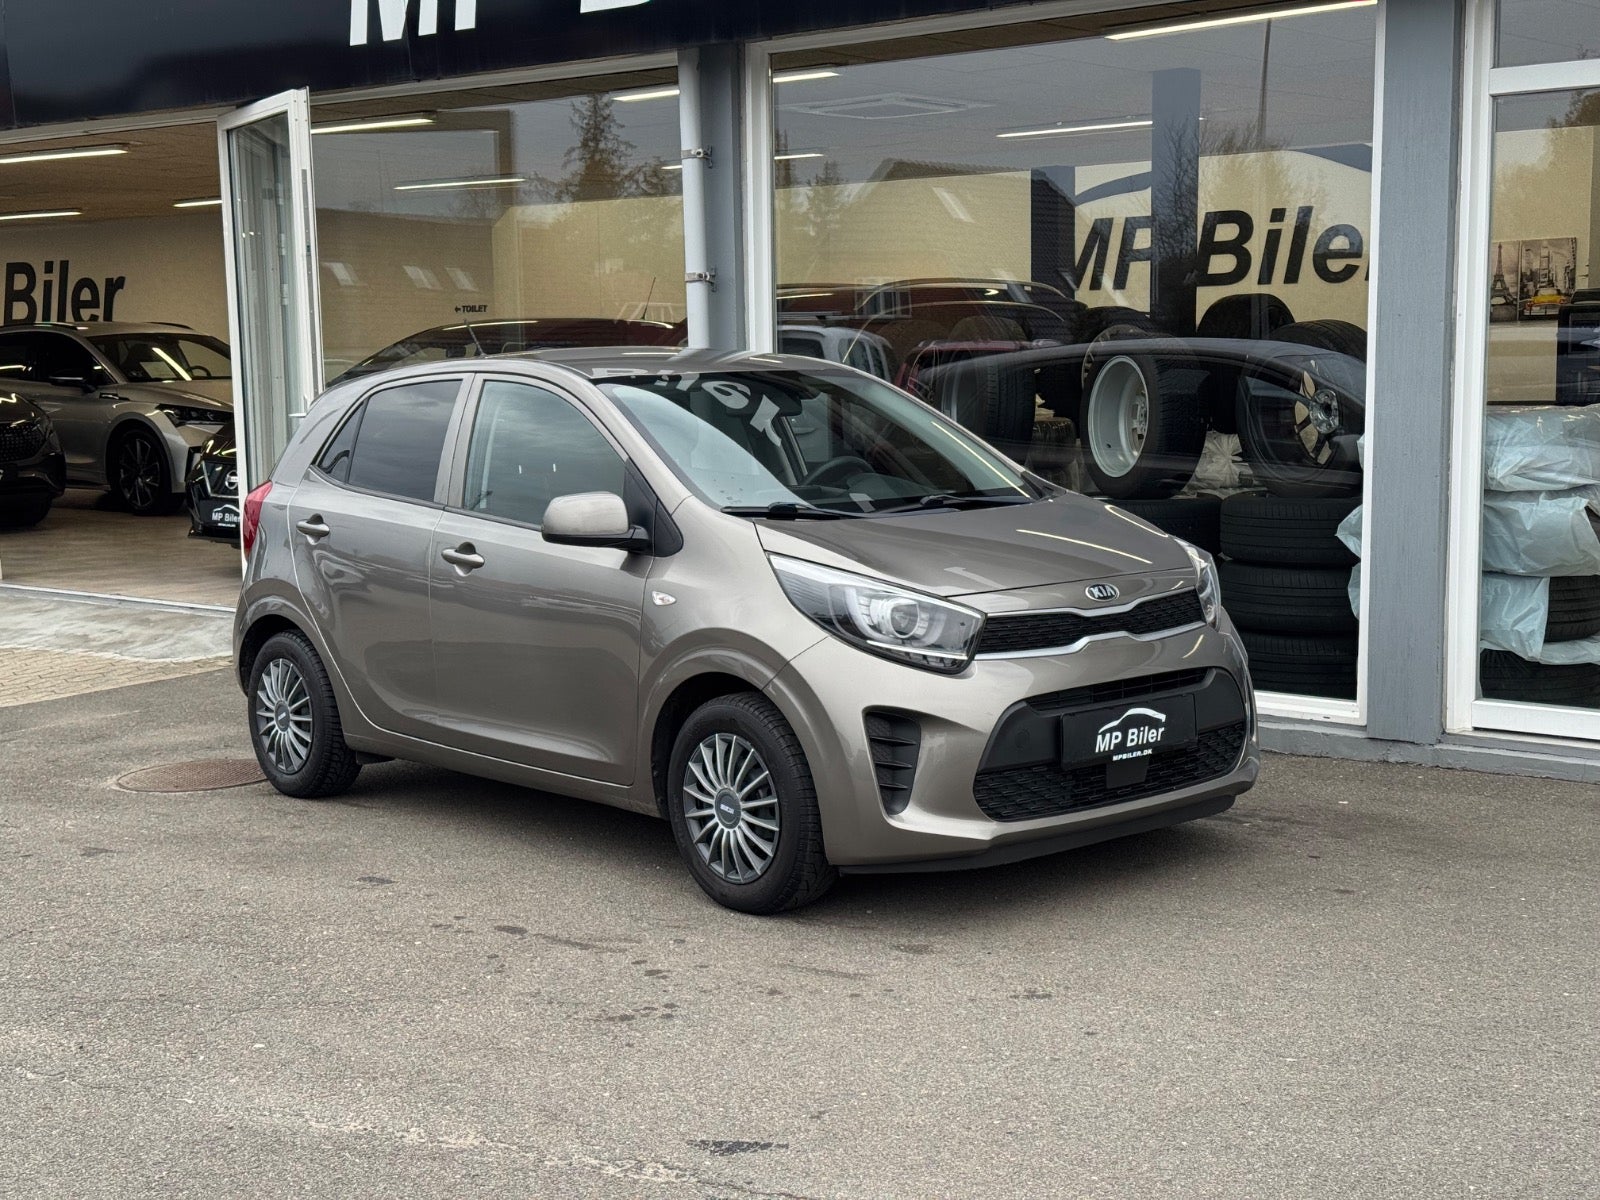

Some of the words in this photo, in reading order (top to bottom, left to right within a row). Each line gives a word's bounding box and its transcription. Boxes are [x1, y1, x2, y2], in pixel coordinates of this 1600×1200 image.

[1197, 206, 1370, 287] Bile
[4, 260, 126, 326] Biler
[461, 304, 488, 313] TOILET
[211, 512, 223, 521] MP
[1090, 585, 1116, 599] KIA
[1095, 731, 1122, 753] MP
[1126, 725, 1165, 747] Biler
